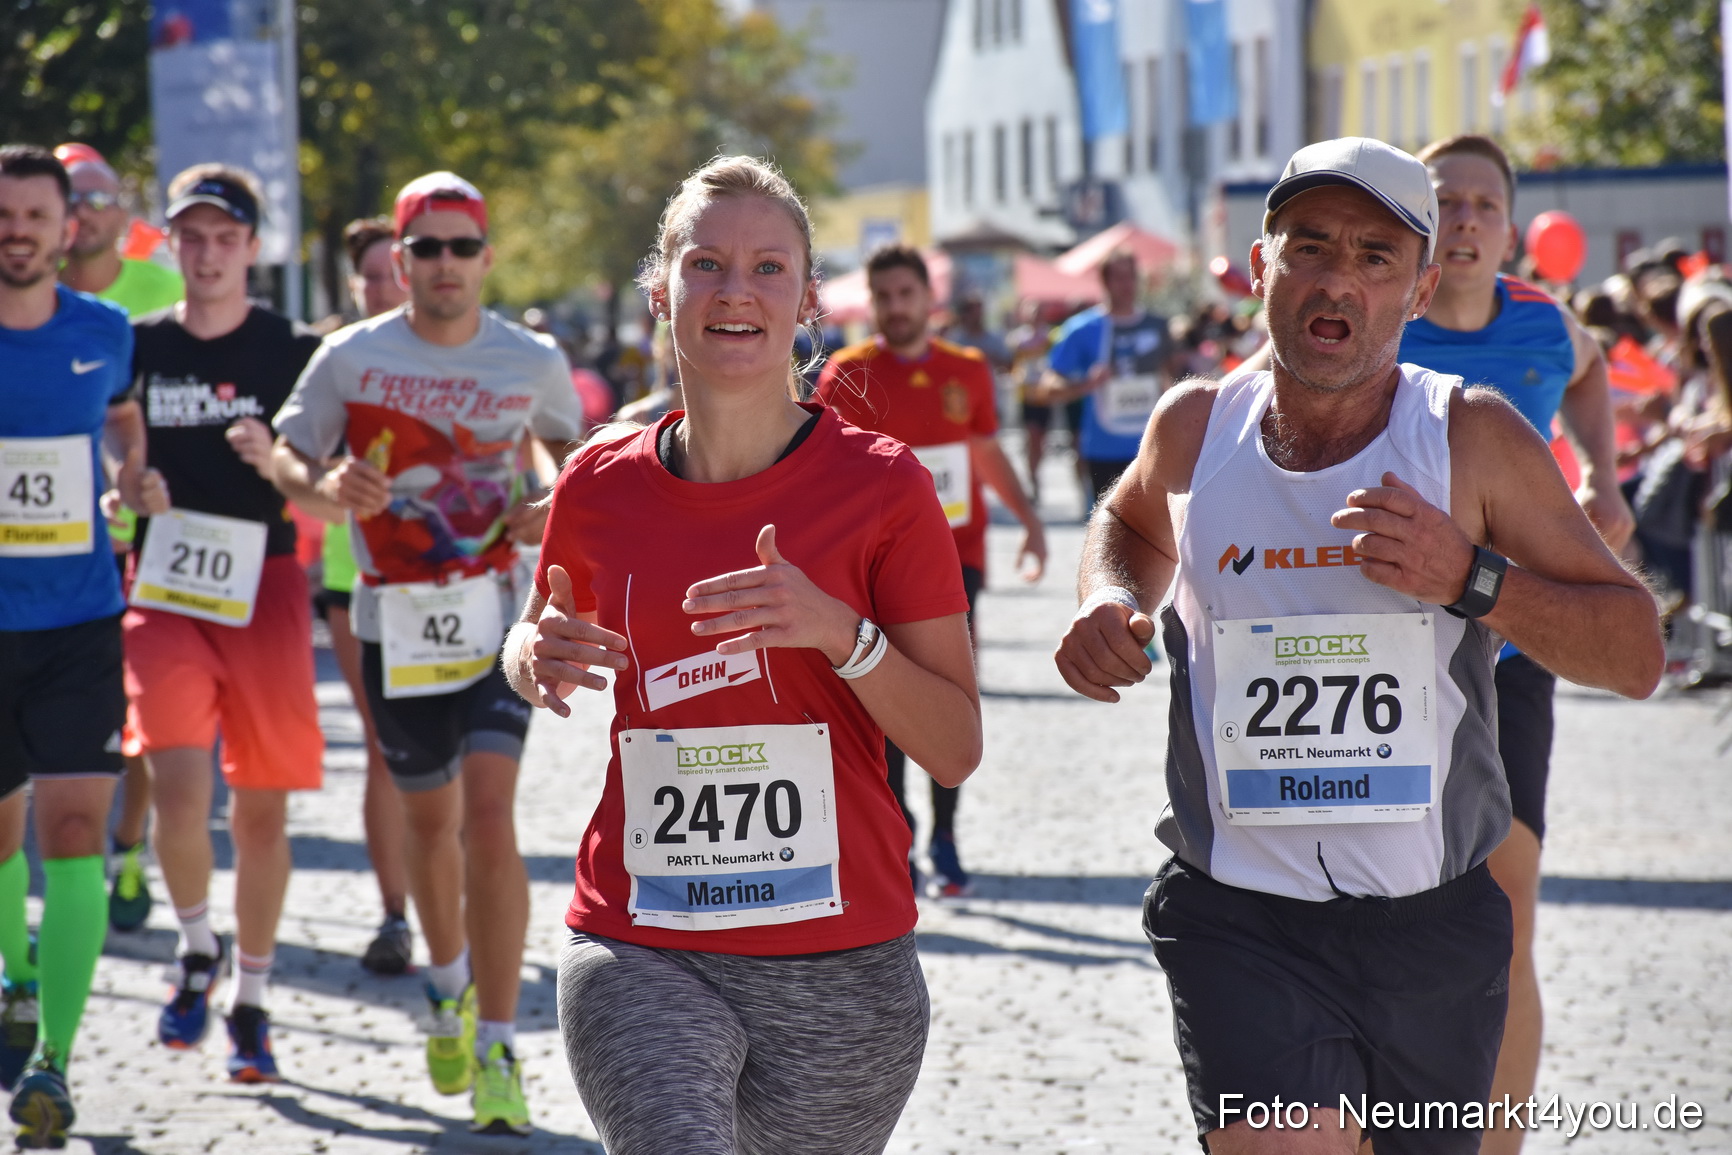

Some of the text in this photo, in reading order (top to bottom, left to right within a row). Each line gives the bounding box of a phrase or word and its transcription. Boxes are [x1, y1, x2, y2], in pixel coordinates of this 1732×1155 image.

[9, 472, 54, 508] 43
[169, 541, 233, 581] 210
[422, 613, 464, 645] 42
[1275, 634, 1369, 658] BOCK
[678, 660, 726, 689] DEHN
[1275, 658, 1301, 667] inspired
[1246, 673, 1402, 737] 2276
[677, 743, 768, 767] BOCK
[1259, 746, 1371, 760] PARTL Neumarkt
[677, 764, 770, 776] inspired by smart concepts
[1280, 774, 1370, 800] Roland
[653, 779, 802, 844] 2470
[667, 851, 775, 866] PARTL Neumarkt
[687, 880, 775, 906] Marina
